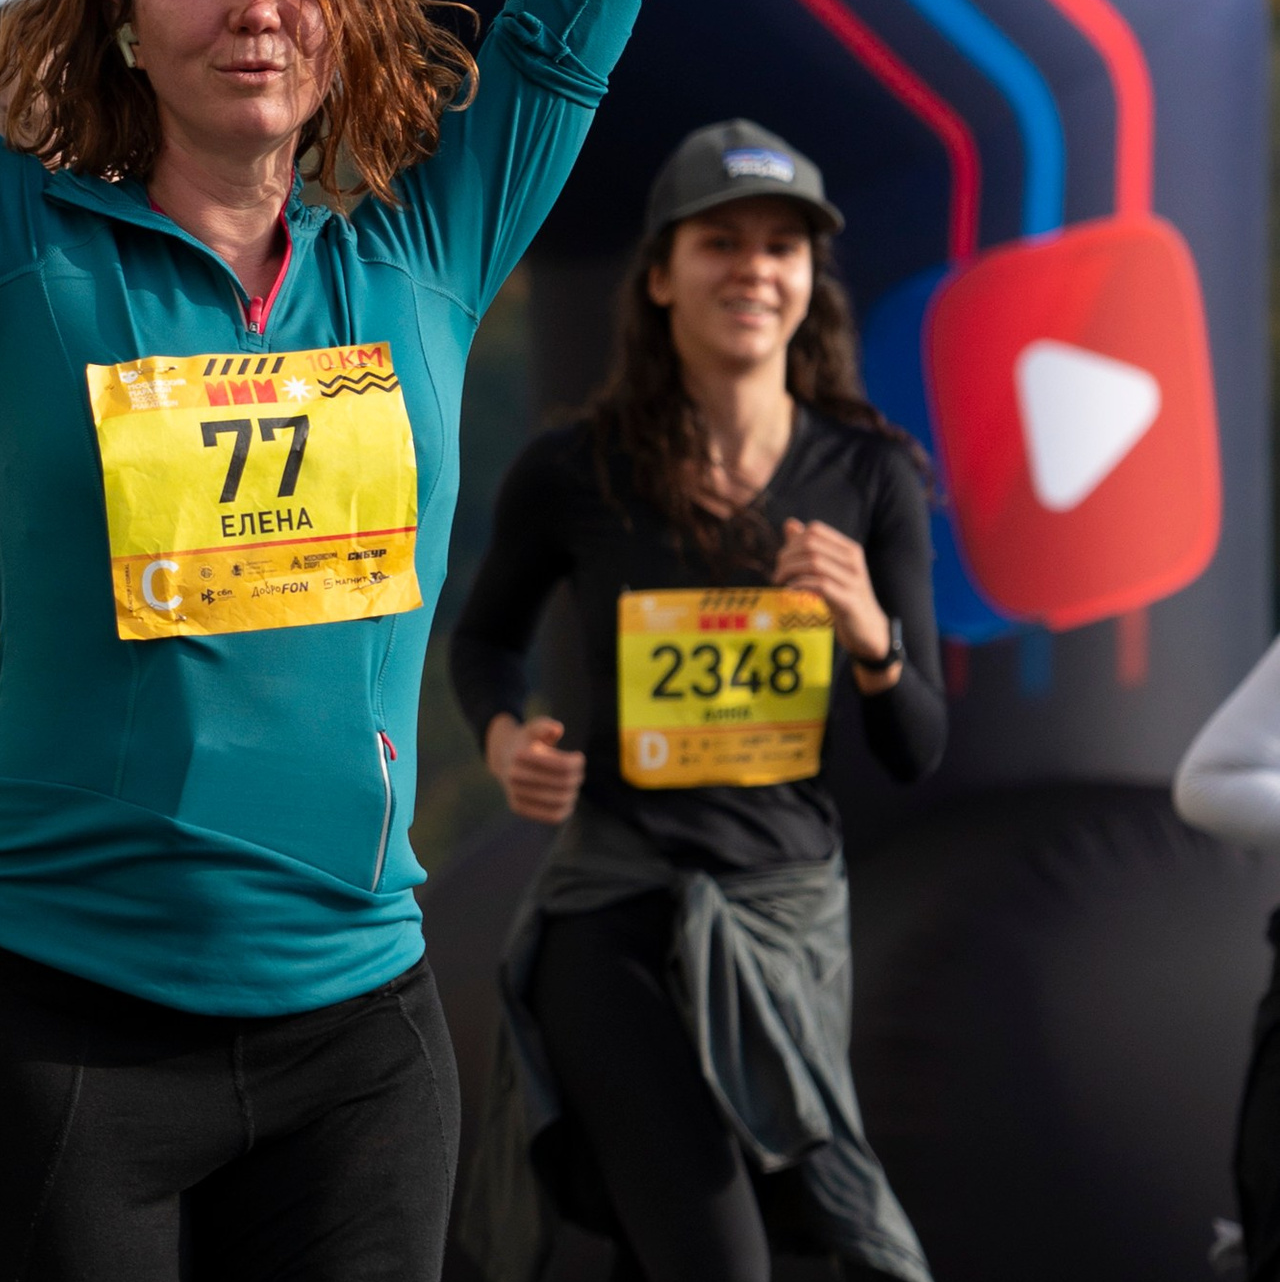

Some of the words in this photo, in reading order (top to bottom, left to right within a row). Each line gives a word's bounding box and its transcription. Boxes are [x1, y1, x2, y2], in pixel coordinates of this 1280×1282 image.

[305, 352, 334, 372] 10
[200, 414, 310, 504] 77
[220, 507, 313, 538] ЕЛЕНА
[347, 549, 387, 561] СИБУР
[142, 560, 183, 612] C
[651, 642, 802, 699] 2348
[638, 731, 669, 771] D
